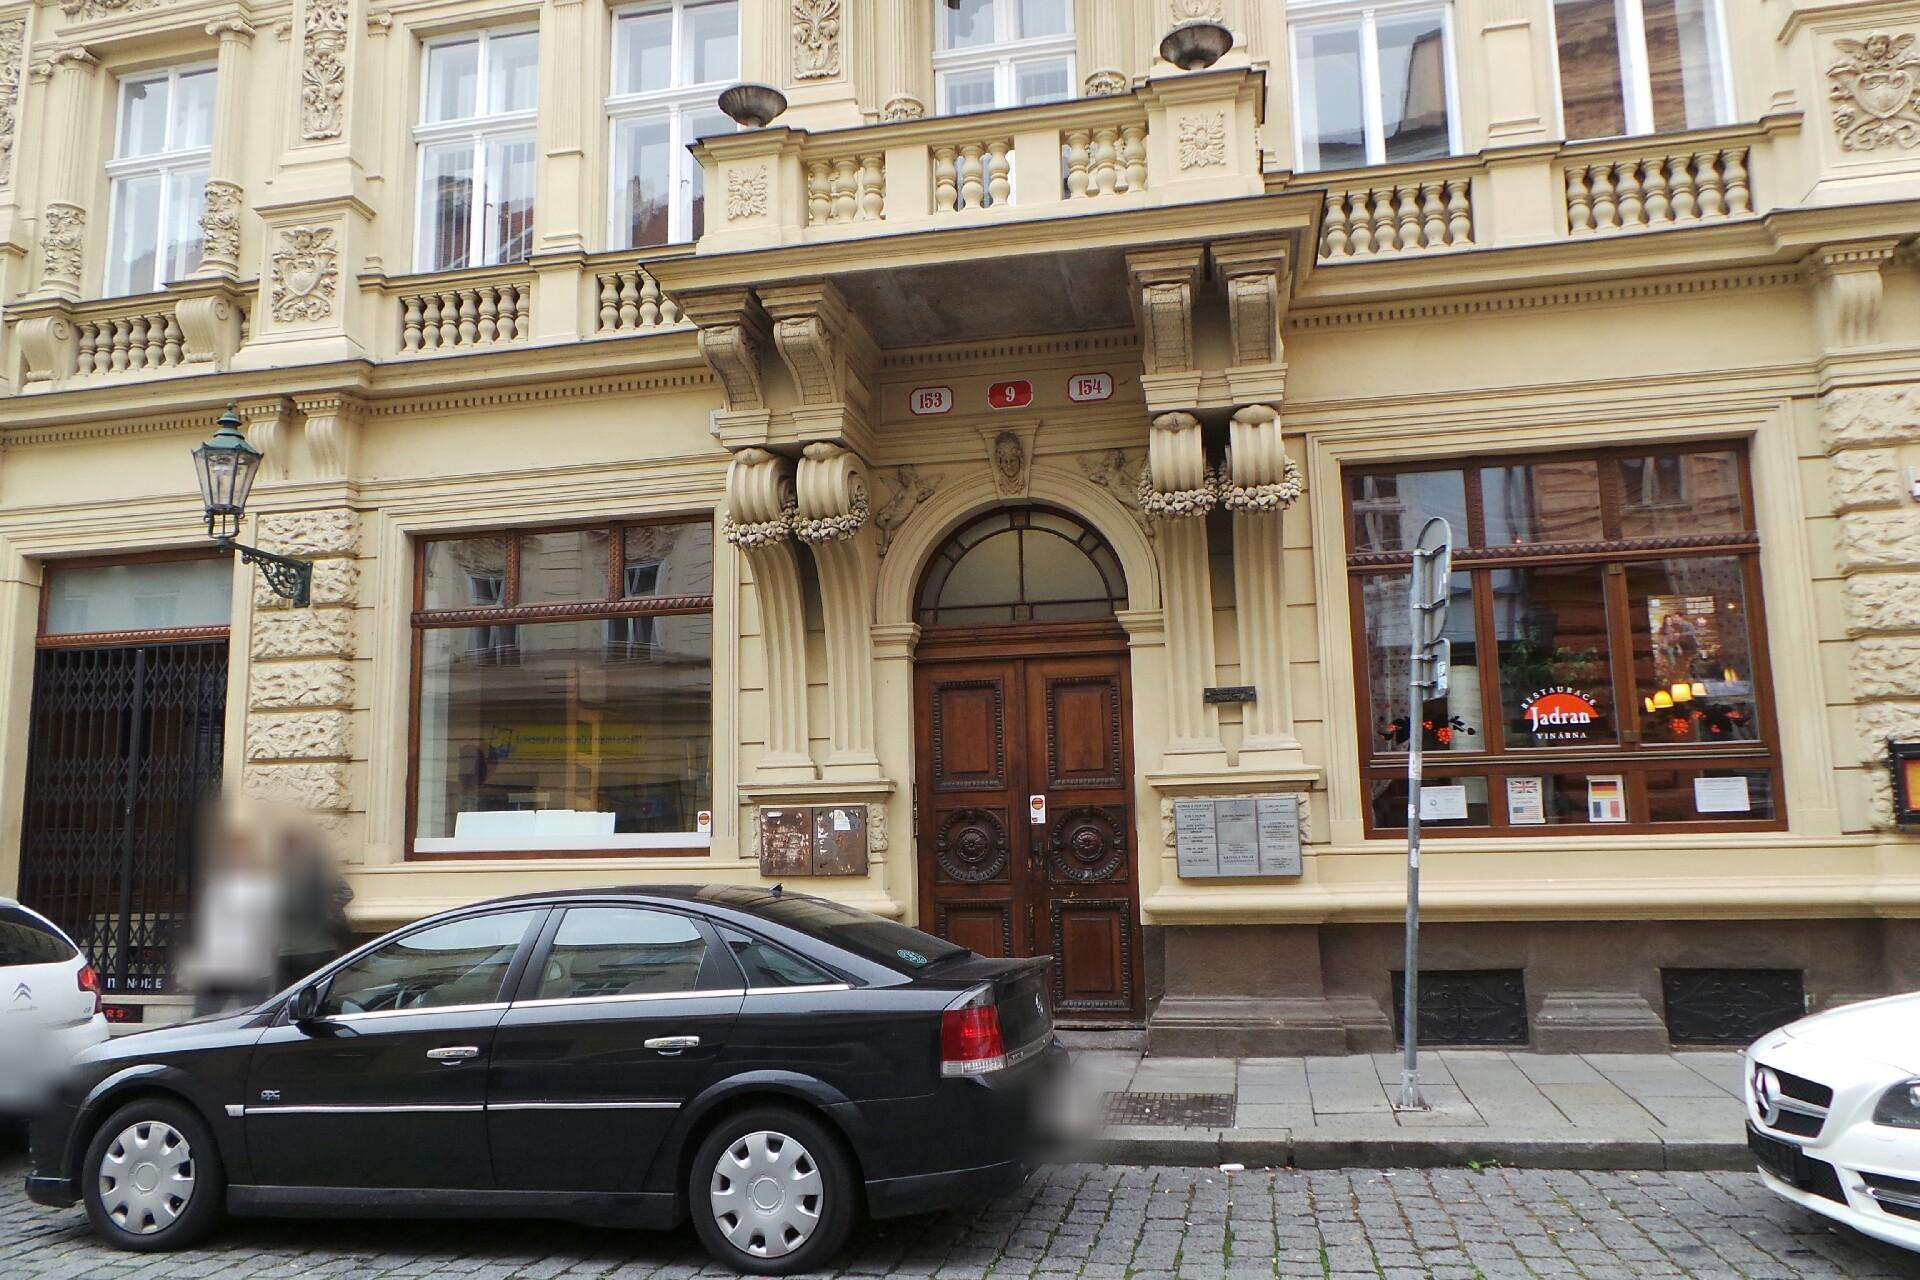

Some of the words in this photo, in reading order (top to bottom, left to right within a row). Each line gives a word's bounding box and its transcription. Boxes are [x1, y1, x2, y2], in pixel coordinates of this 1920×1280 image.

[1005, 386, 1016, 402] 9
[1077, 378, 1103, 397] 154
[919, 392, 943, 410] 153
[1520, 685, 1598, 709] RESTAURACE
[1530, 706, 1591, 732] Jadran
